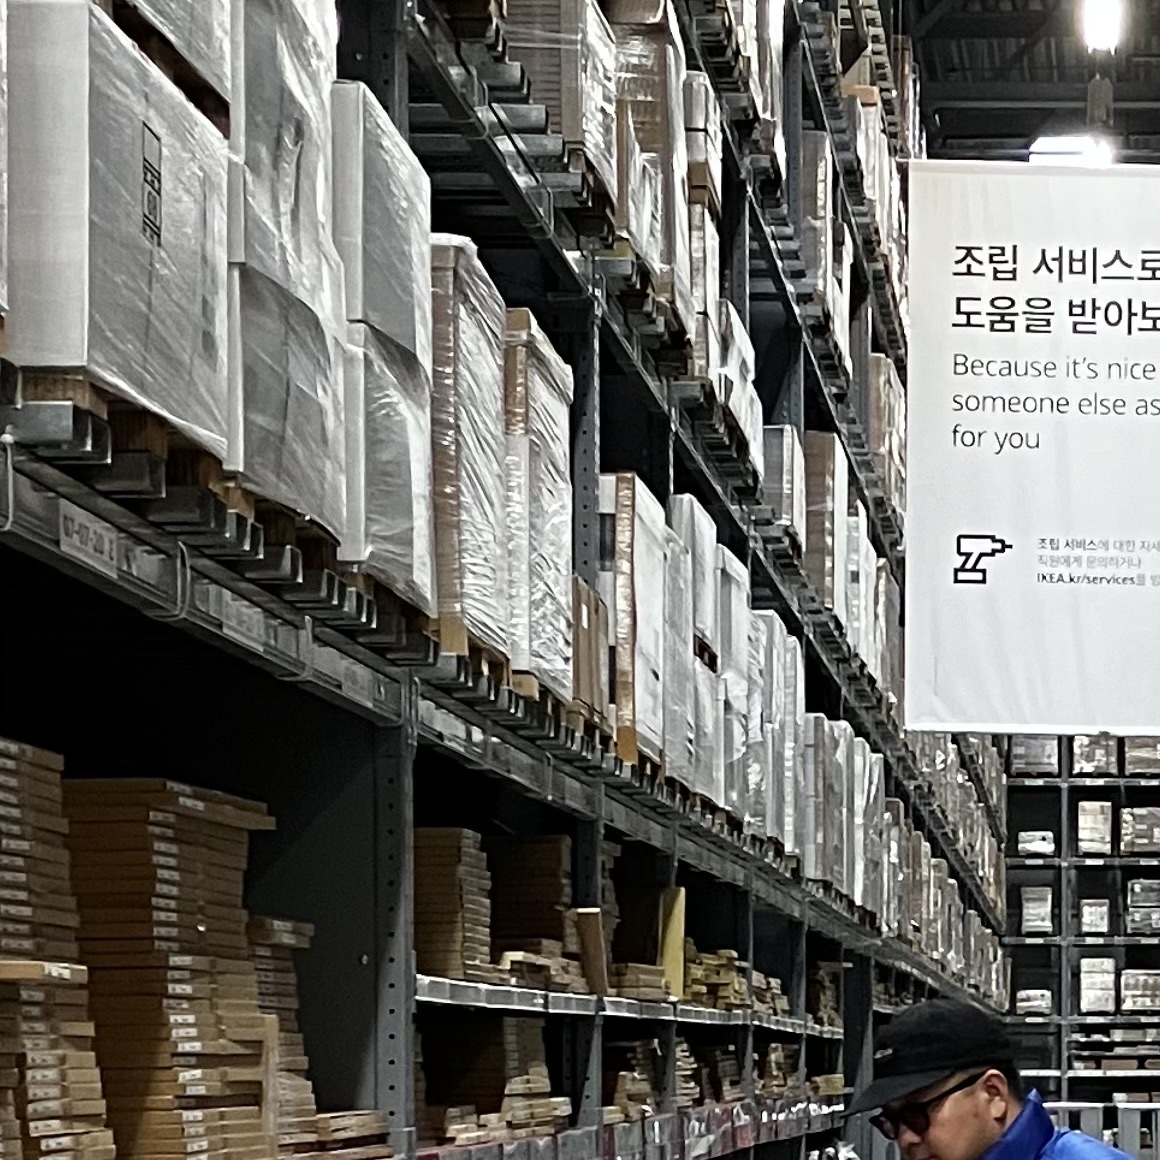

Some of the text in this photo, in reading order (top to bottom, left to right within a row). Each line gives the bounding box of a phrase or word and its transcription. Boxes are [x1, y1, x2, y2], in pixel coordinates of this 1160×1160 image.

[952, 244, 1018, 282] 조립
[952, 295, 1055, 335] 도움을
[952, 353, 1057, 379] Because
[1065, 356, 1099, 380] it's
[1107, 357, 1157, 381] nice
[952, 394, 1070, 415] someone
[1078, 391, 1126, 416] else
[952, 423, 1040, 456] for you
[1037, 537, 1060, 551] 조립
[1064, 537, 1110, 552] 서비스에
[1113, 540, 1136, 553] 대한
[1037, 554, 1083, 568] 직원에게
